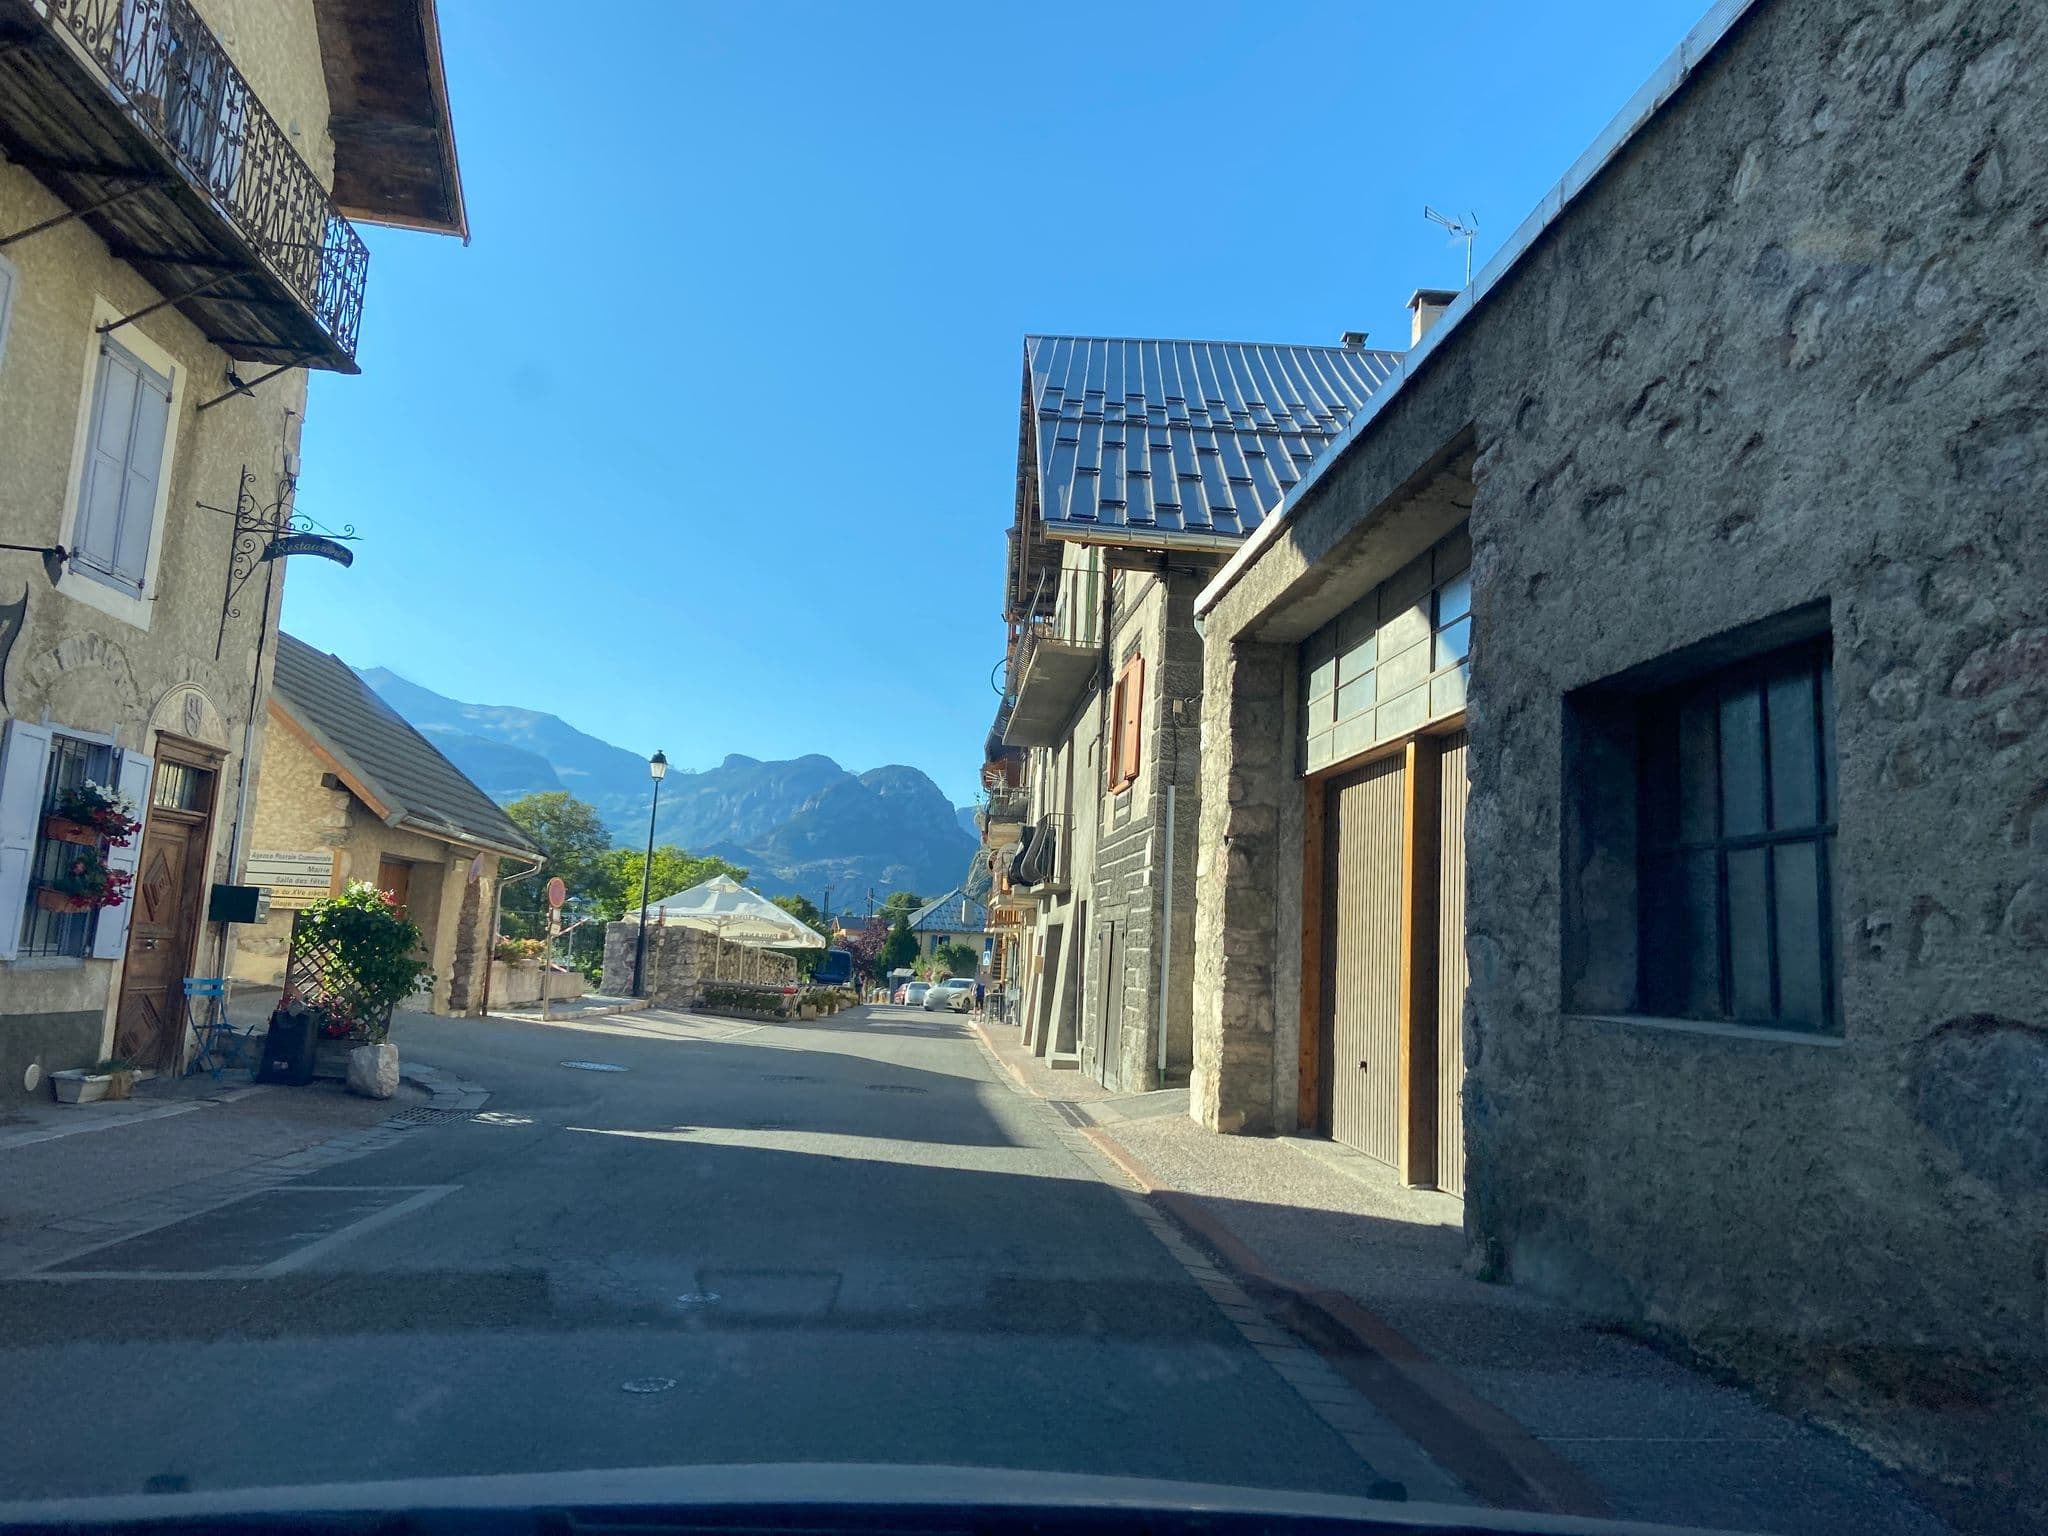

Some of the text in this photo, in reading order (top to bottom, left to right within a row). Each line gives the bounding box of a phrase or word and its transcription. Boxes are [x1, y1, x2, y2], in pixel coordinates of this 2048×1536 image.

[251, 851, 332, 862] Agence Postale Communale
[276, 876, 293, 884] Salle
